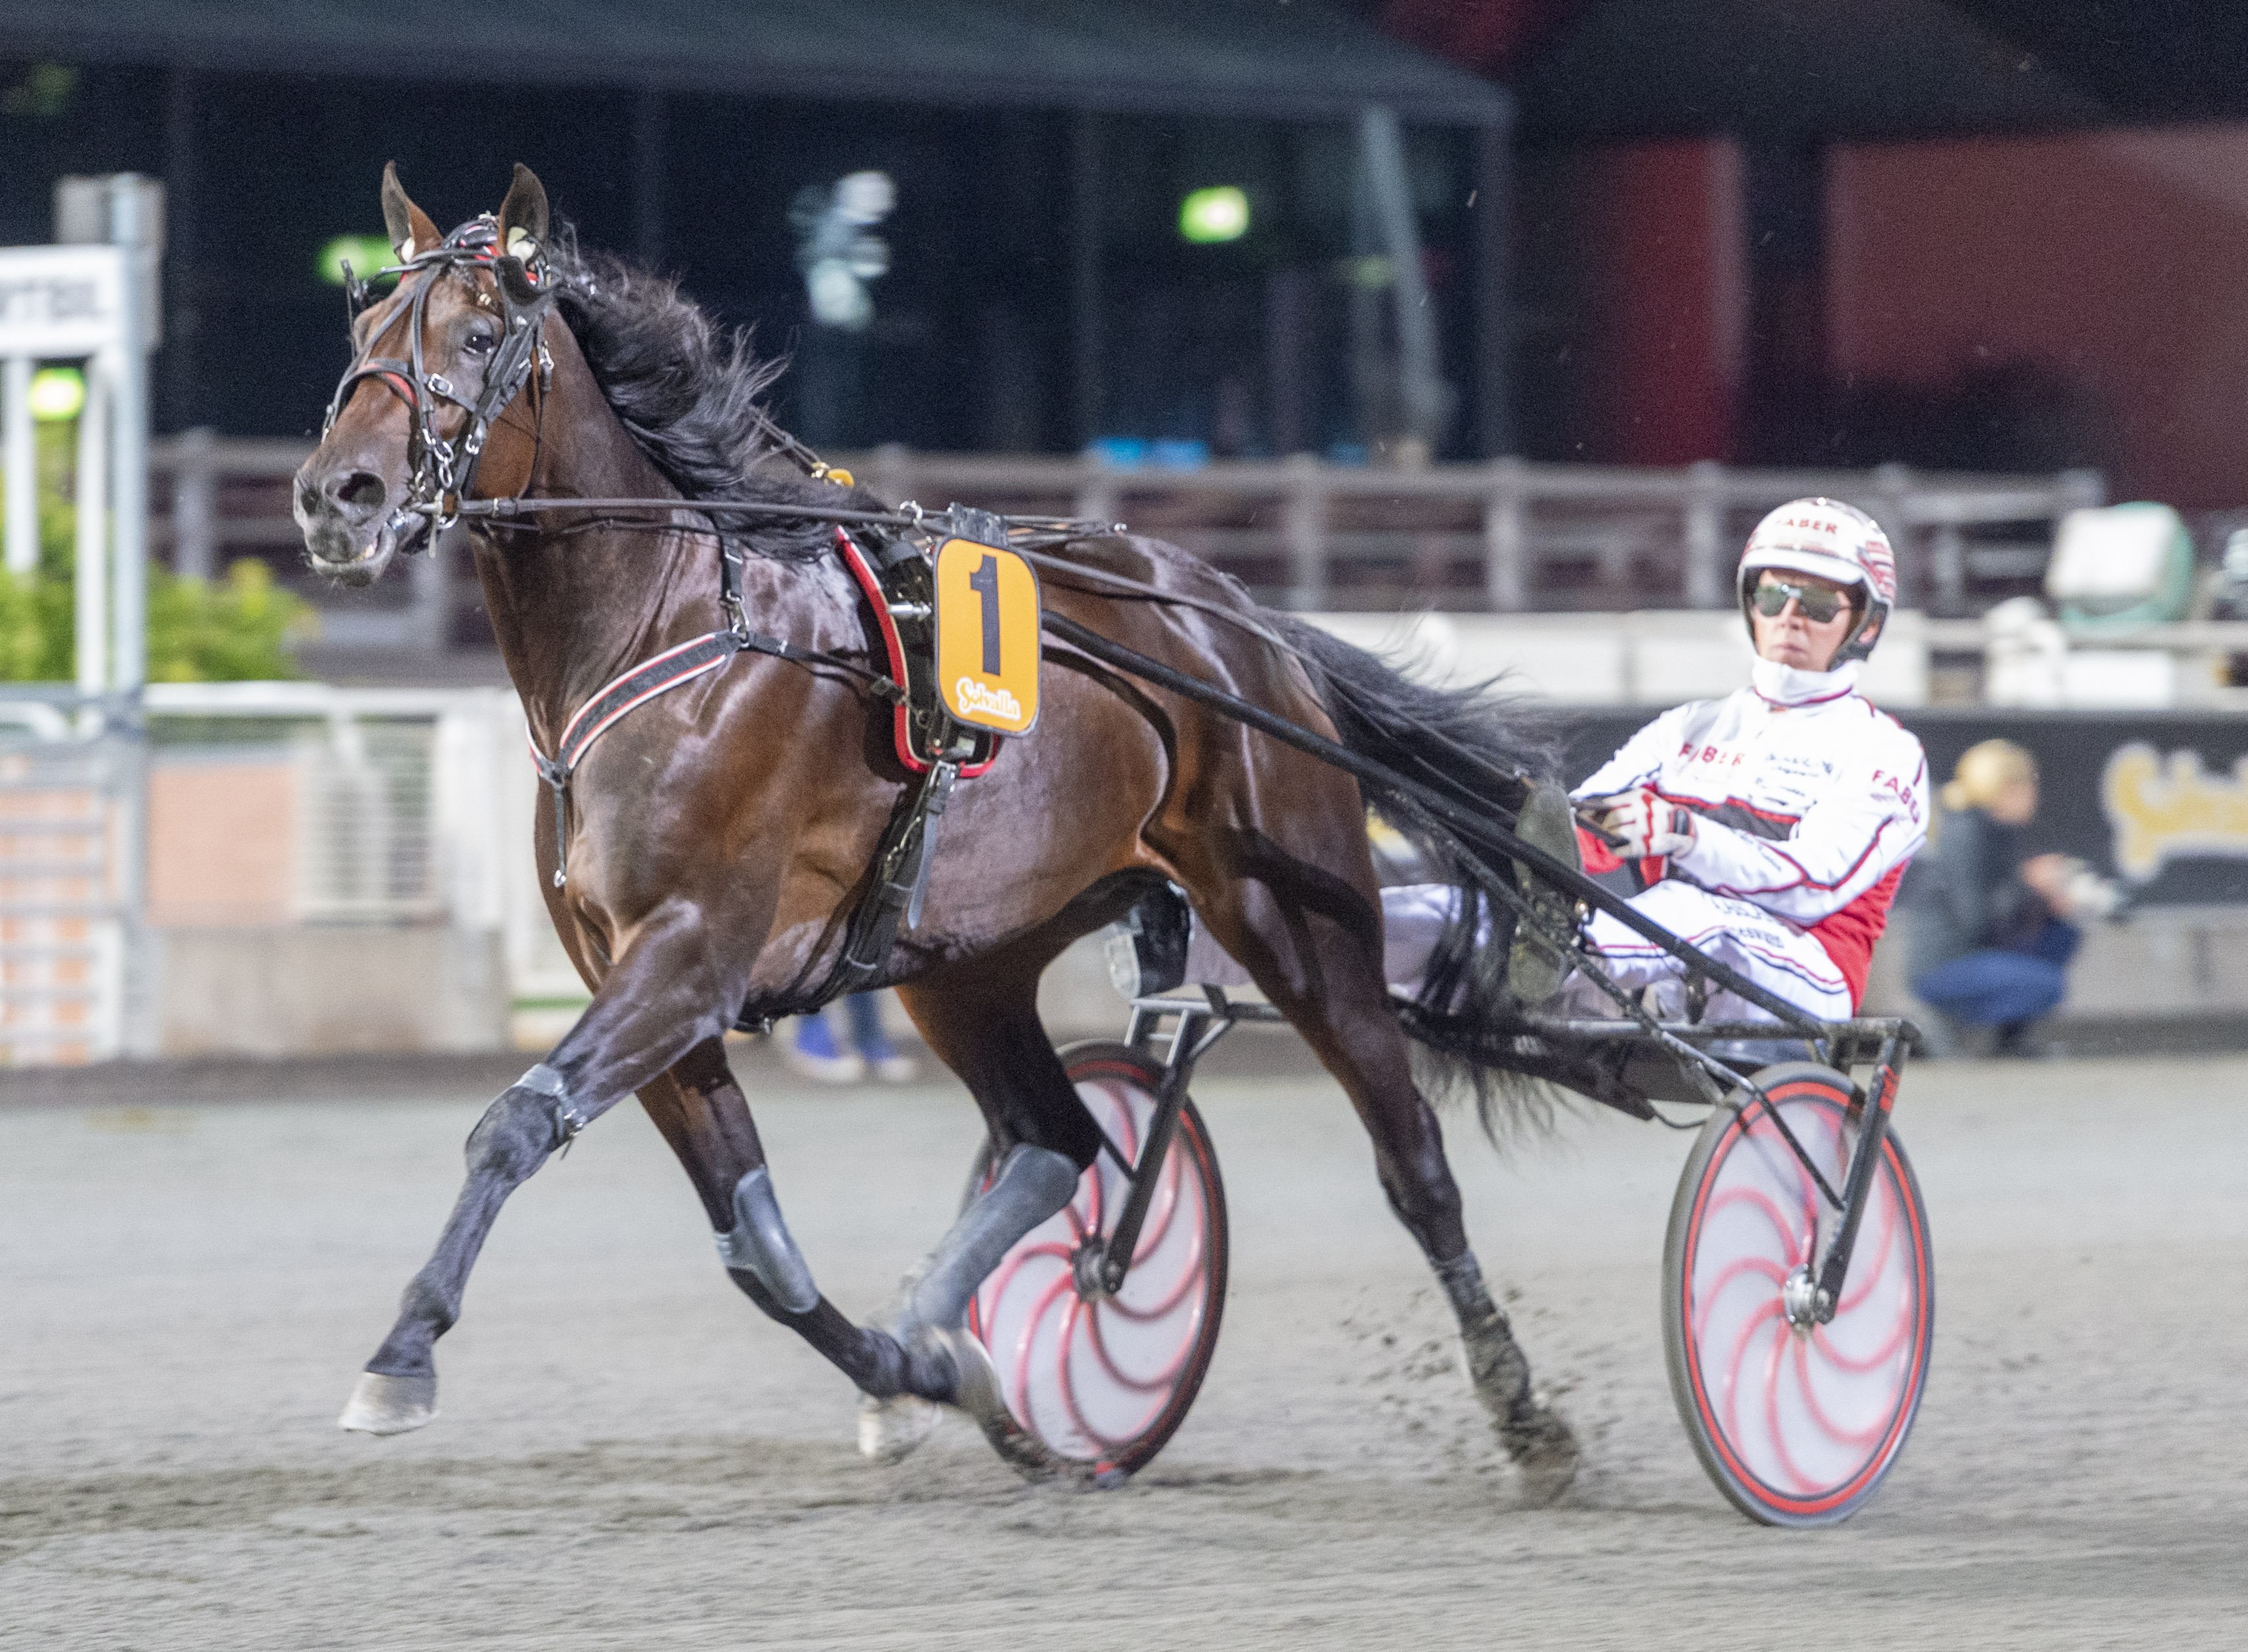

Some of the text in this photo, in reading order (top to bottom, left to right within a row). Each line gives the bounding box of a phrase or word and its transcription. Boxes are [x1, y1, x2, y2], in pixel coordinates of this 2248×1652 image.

[1775, 518, 1838, 535] ABER
[969, 554, 1001, 677] 1
[956, 678, 1021, 720] Solvalla
[1872, 769, 1919, 824] FABE
